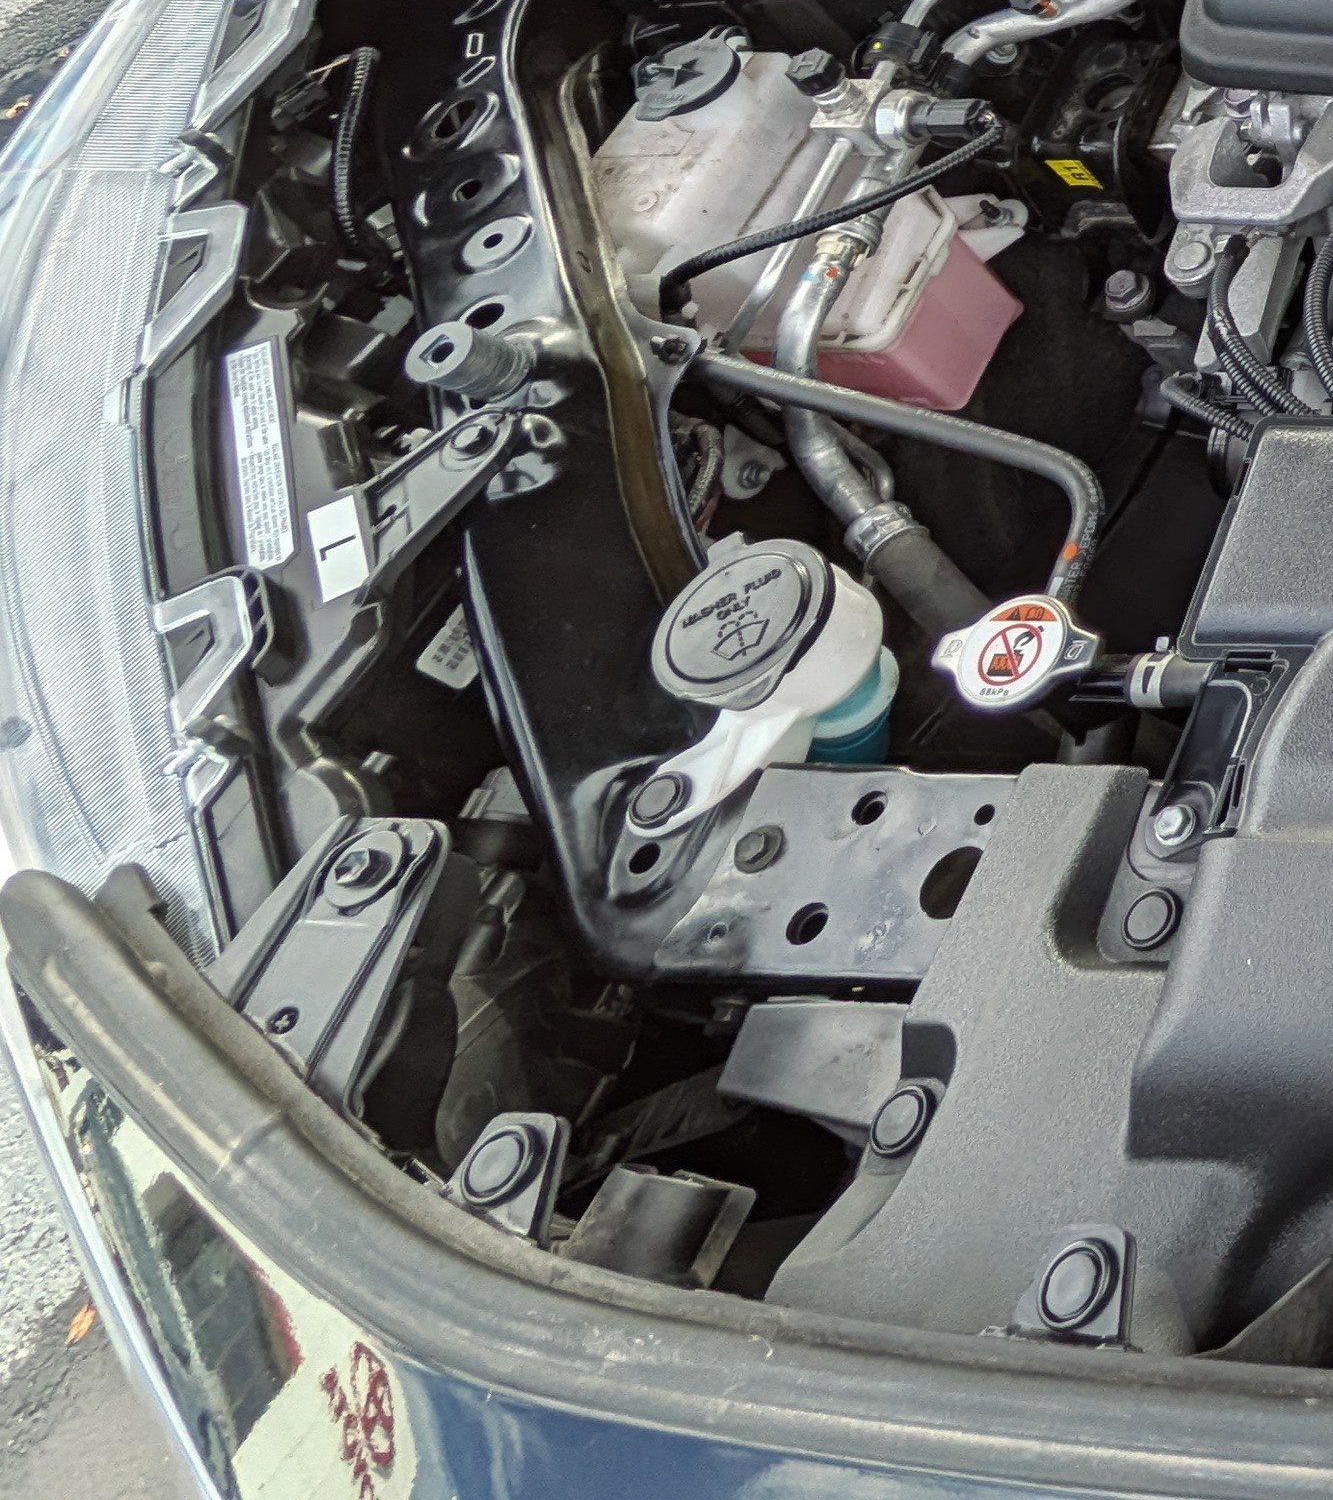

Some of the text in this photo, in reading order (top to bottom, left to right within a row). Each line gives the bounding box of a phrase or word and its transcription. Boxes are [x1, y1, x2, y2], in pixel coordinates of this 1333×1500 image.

[319, 534, 356, 562] L
[682, 568, 782, 629] WASHER FLUID
[716, 596, 751, 620] ONLY
